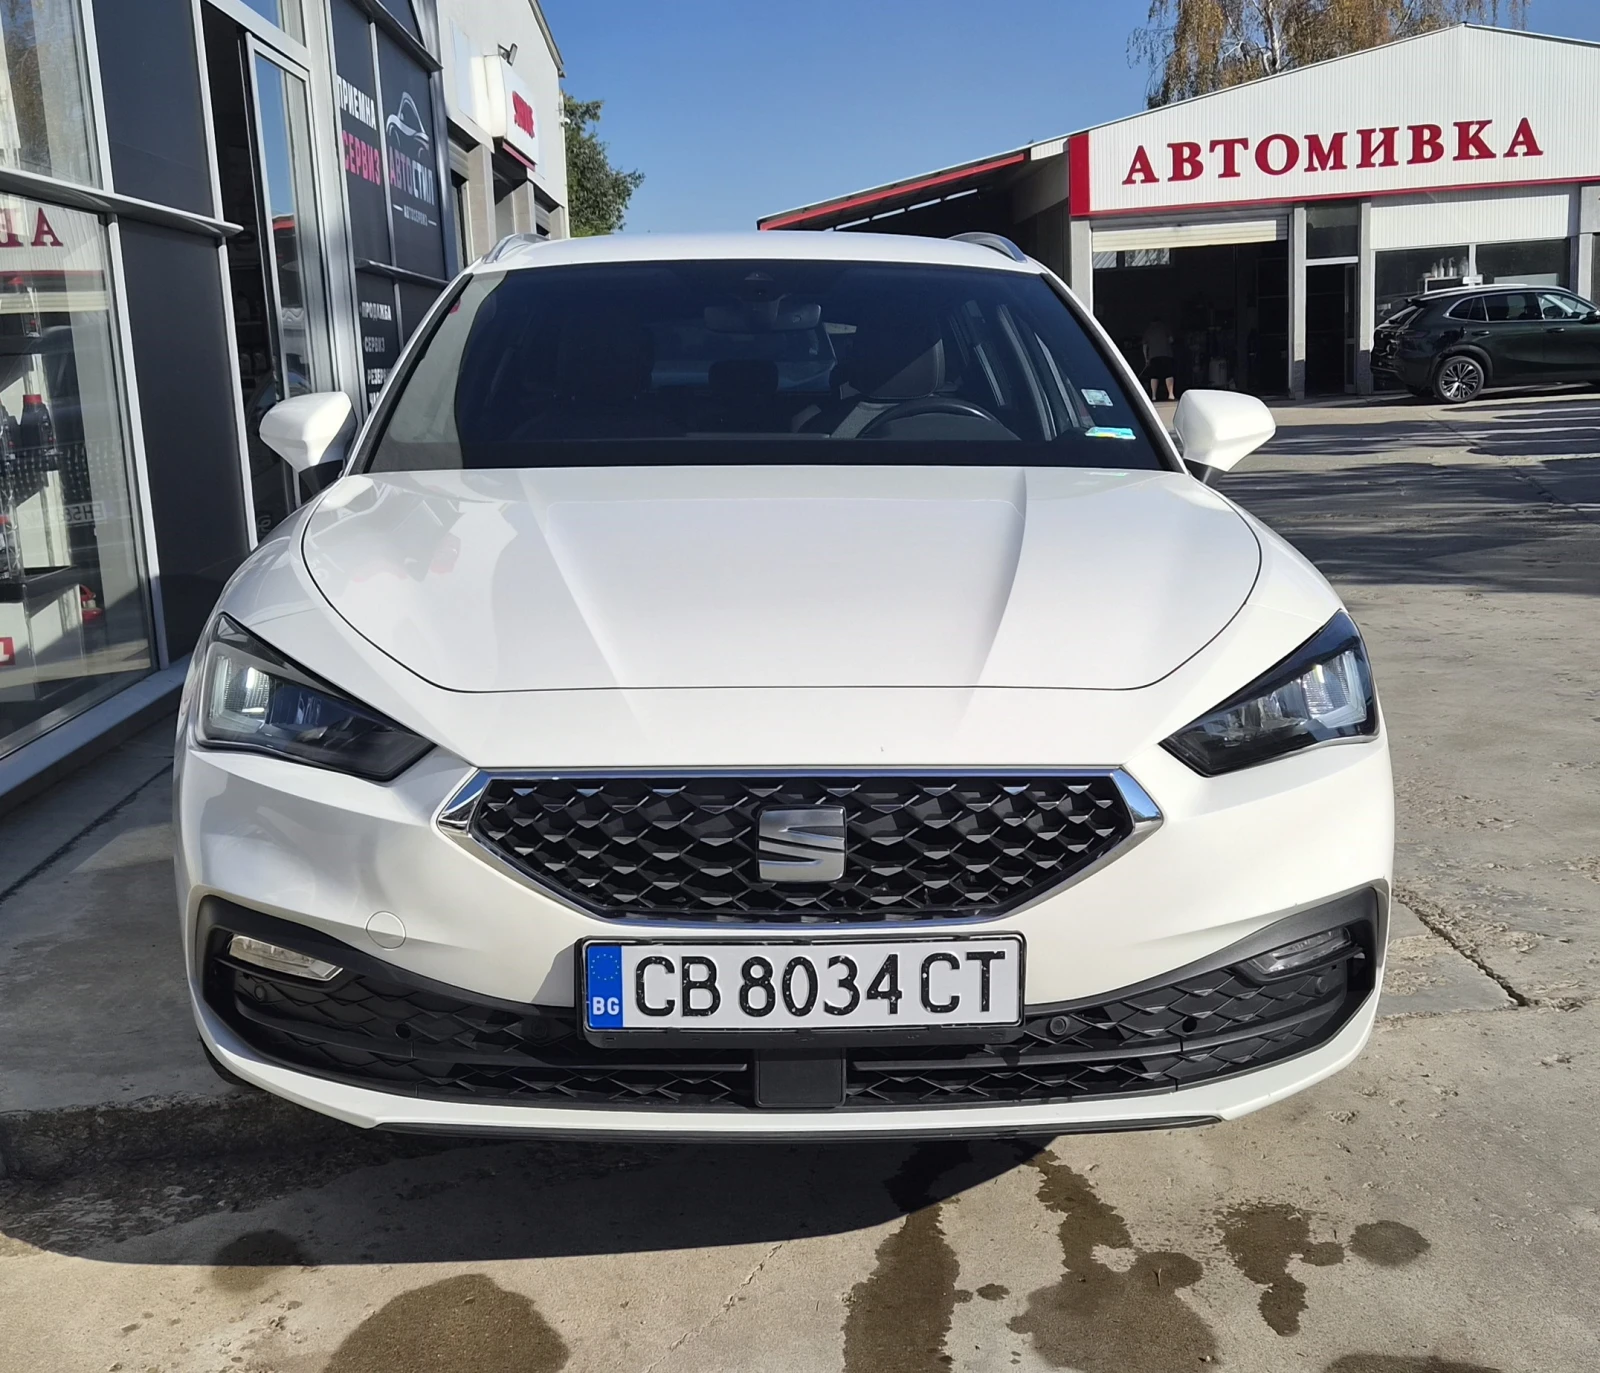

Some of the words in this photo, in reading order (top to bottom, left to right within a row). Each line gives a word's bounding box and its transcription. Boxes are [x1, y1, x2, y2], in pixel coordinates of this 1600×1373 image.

[337, 74, 377, 131] ПРИЕМНА
[342, 129, 381, 186] СЕРВИЗ
[388, 146, 435, 206] АВТОСТИЛ
[1121, 117, 1544, 186] АВТОМИВКА
[592, 998, 620, 1015] BG
[635, 955, 721, 1018] CB
[740, 953, 903, 1018] 8034
[920, 951, 1007, 1014] CT
